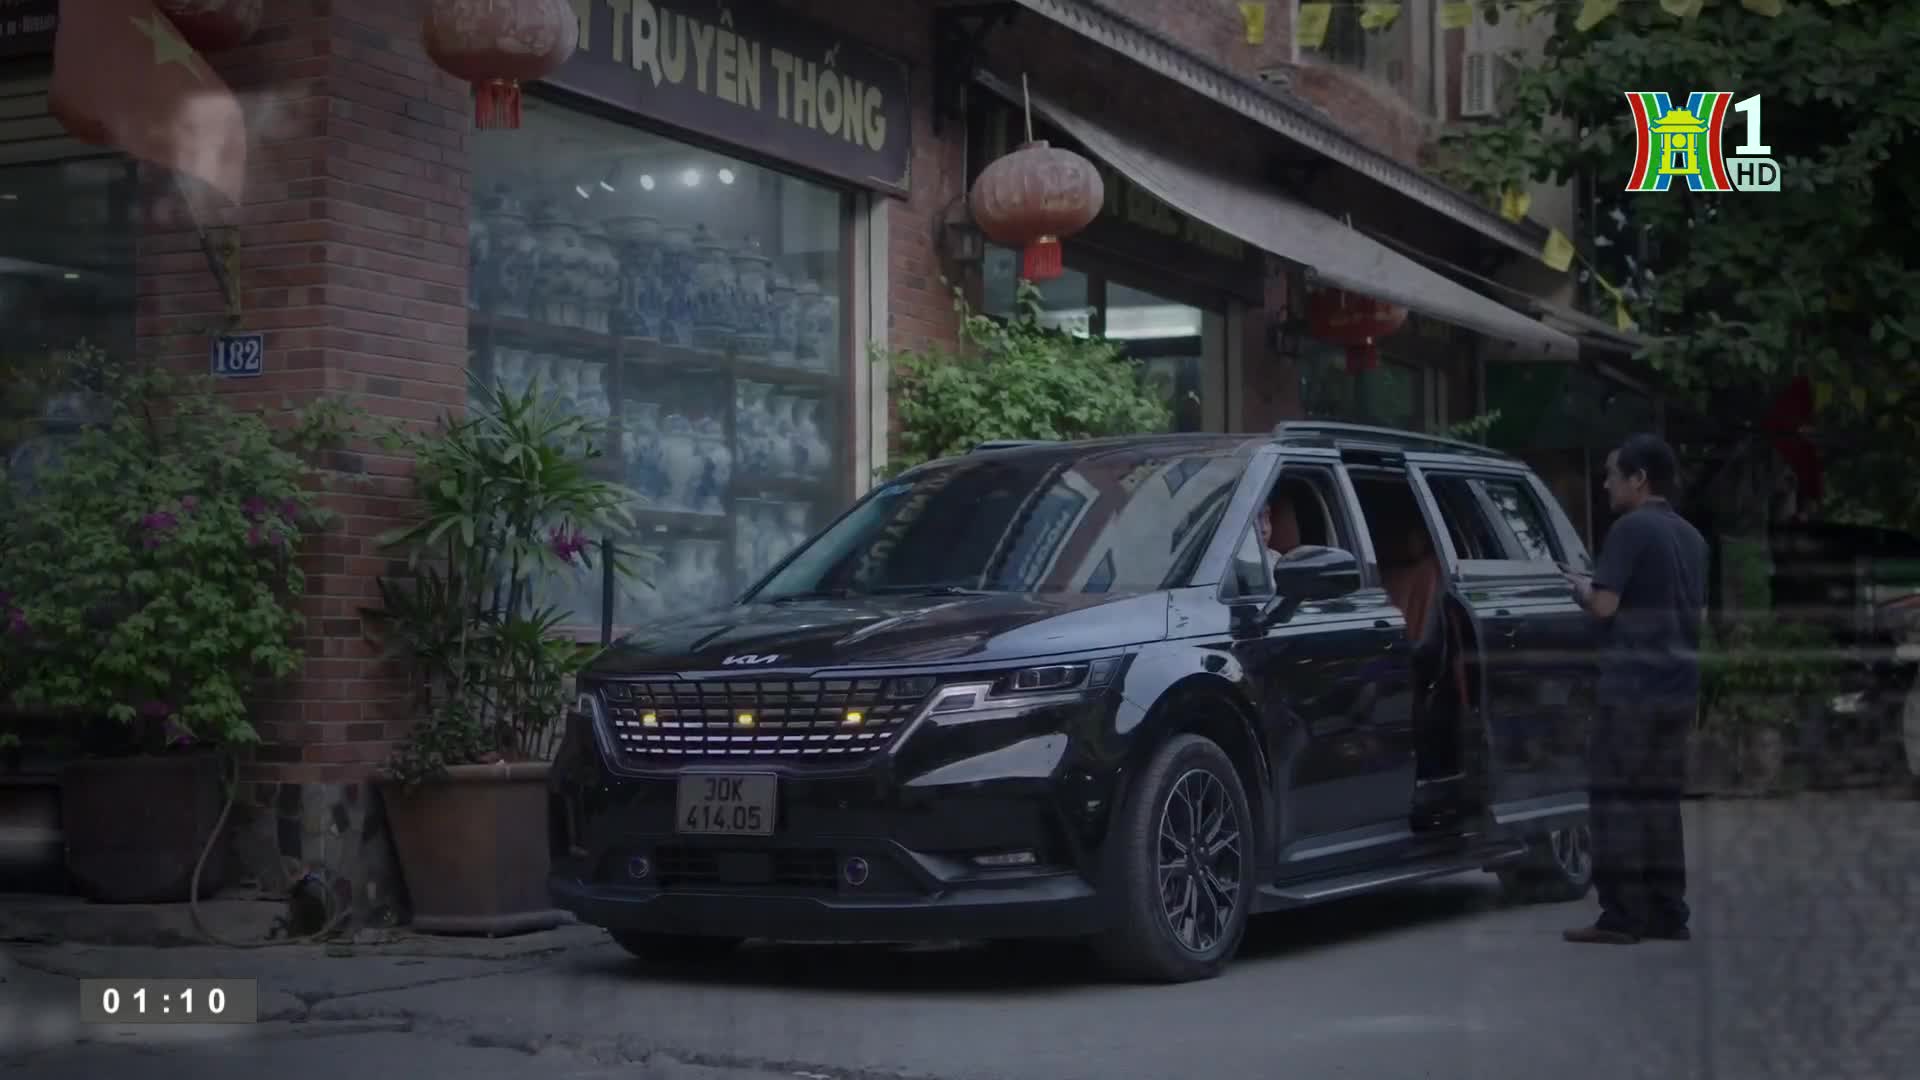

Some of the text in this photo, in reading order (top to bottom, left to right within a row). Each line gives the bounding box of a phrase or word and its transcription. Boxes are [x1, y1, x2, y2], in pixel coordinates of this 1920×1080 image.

[771, 43, 887, 151] THỐNG
[216, 340, 259, 371] 182
[704, 777, 743, 801] 30K
[686, 805, 761, 831] 414.05
